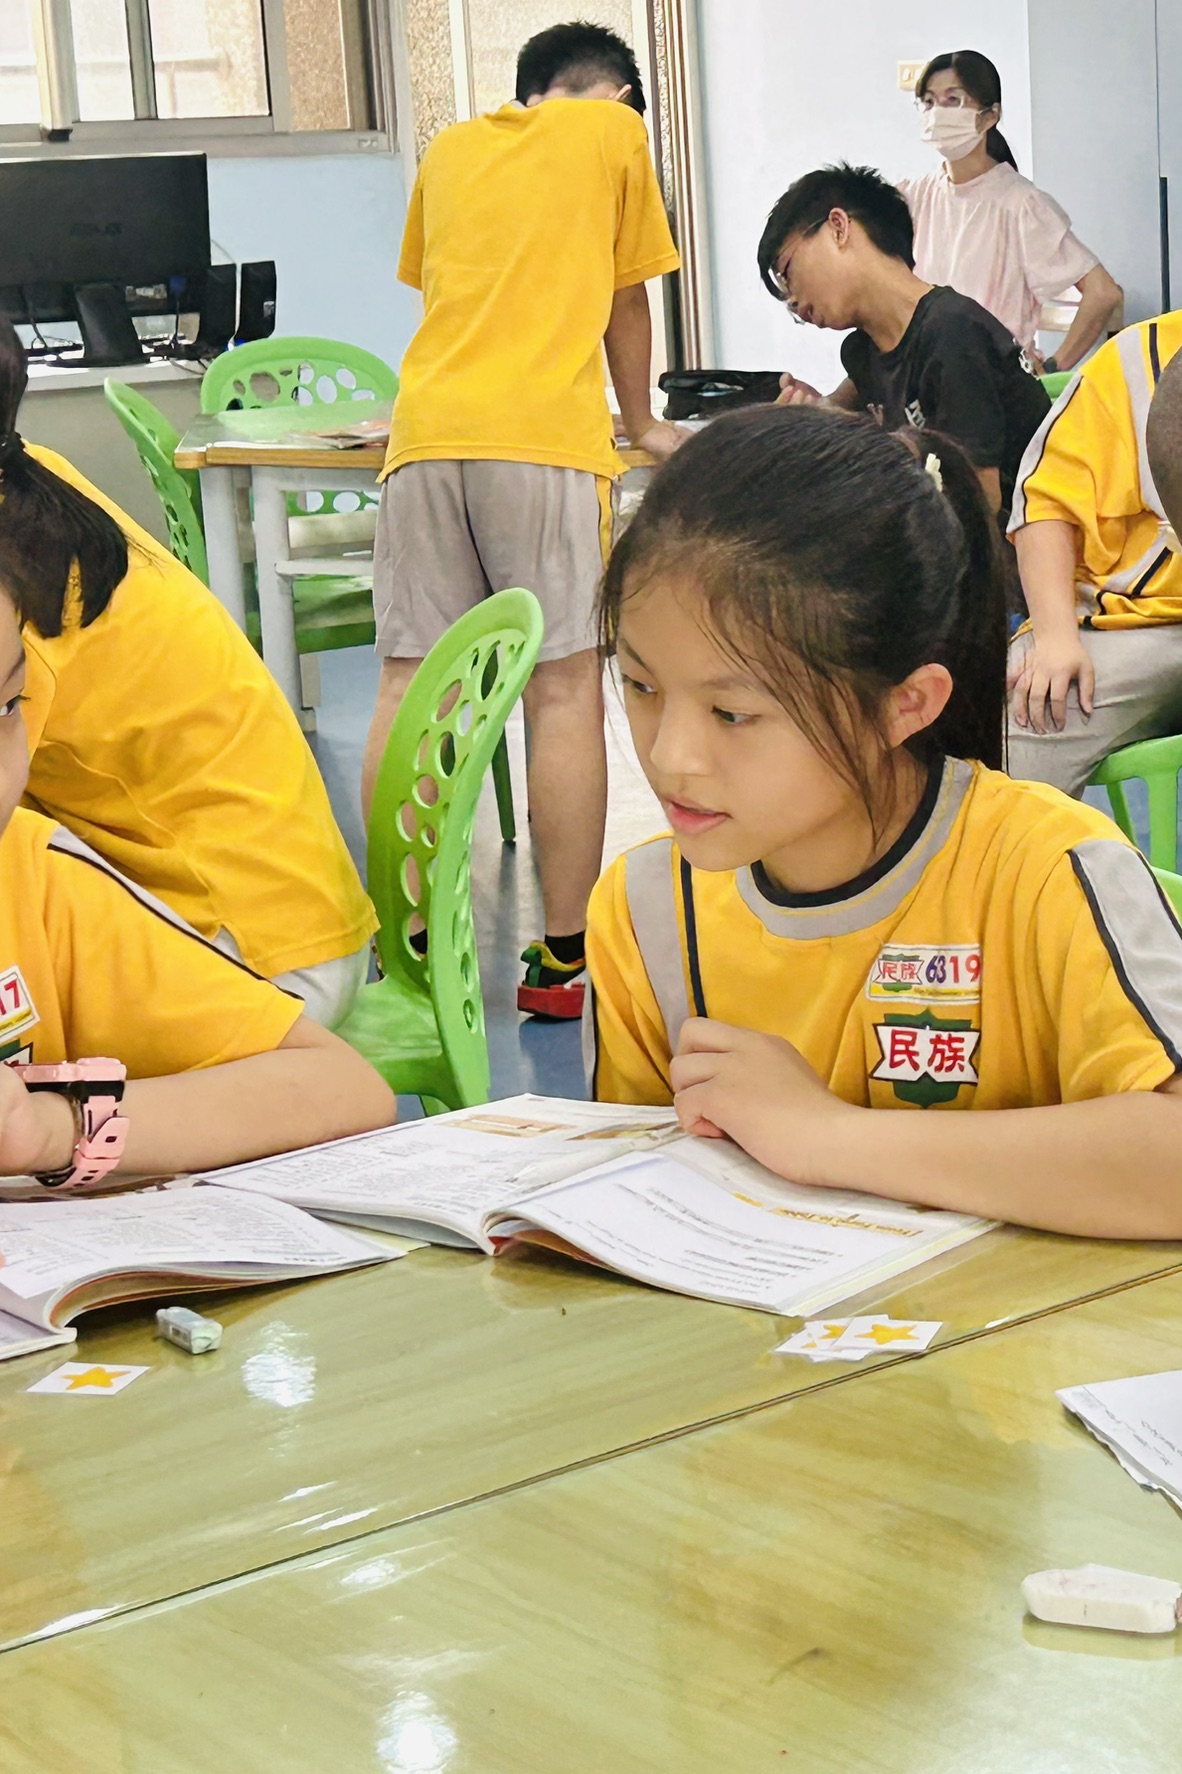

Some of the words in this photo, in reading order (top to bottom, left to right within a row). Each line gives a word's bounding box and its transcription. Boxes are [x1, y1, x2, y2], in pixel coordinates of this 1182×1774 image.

[881, 962, 917, 980] 民族
[925, 955, 981, 984] 6319
[889, 1029, 965, 1073] 民族
